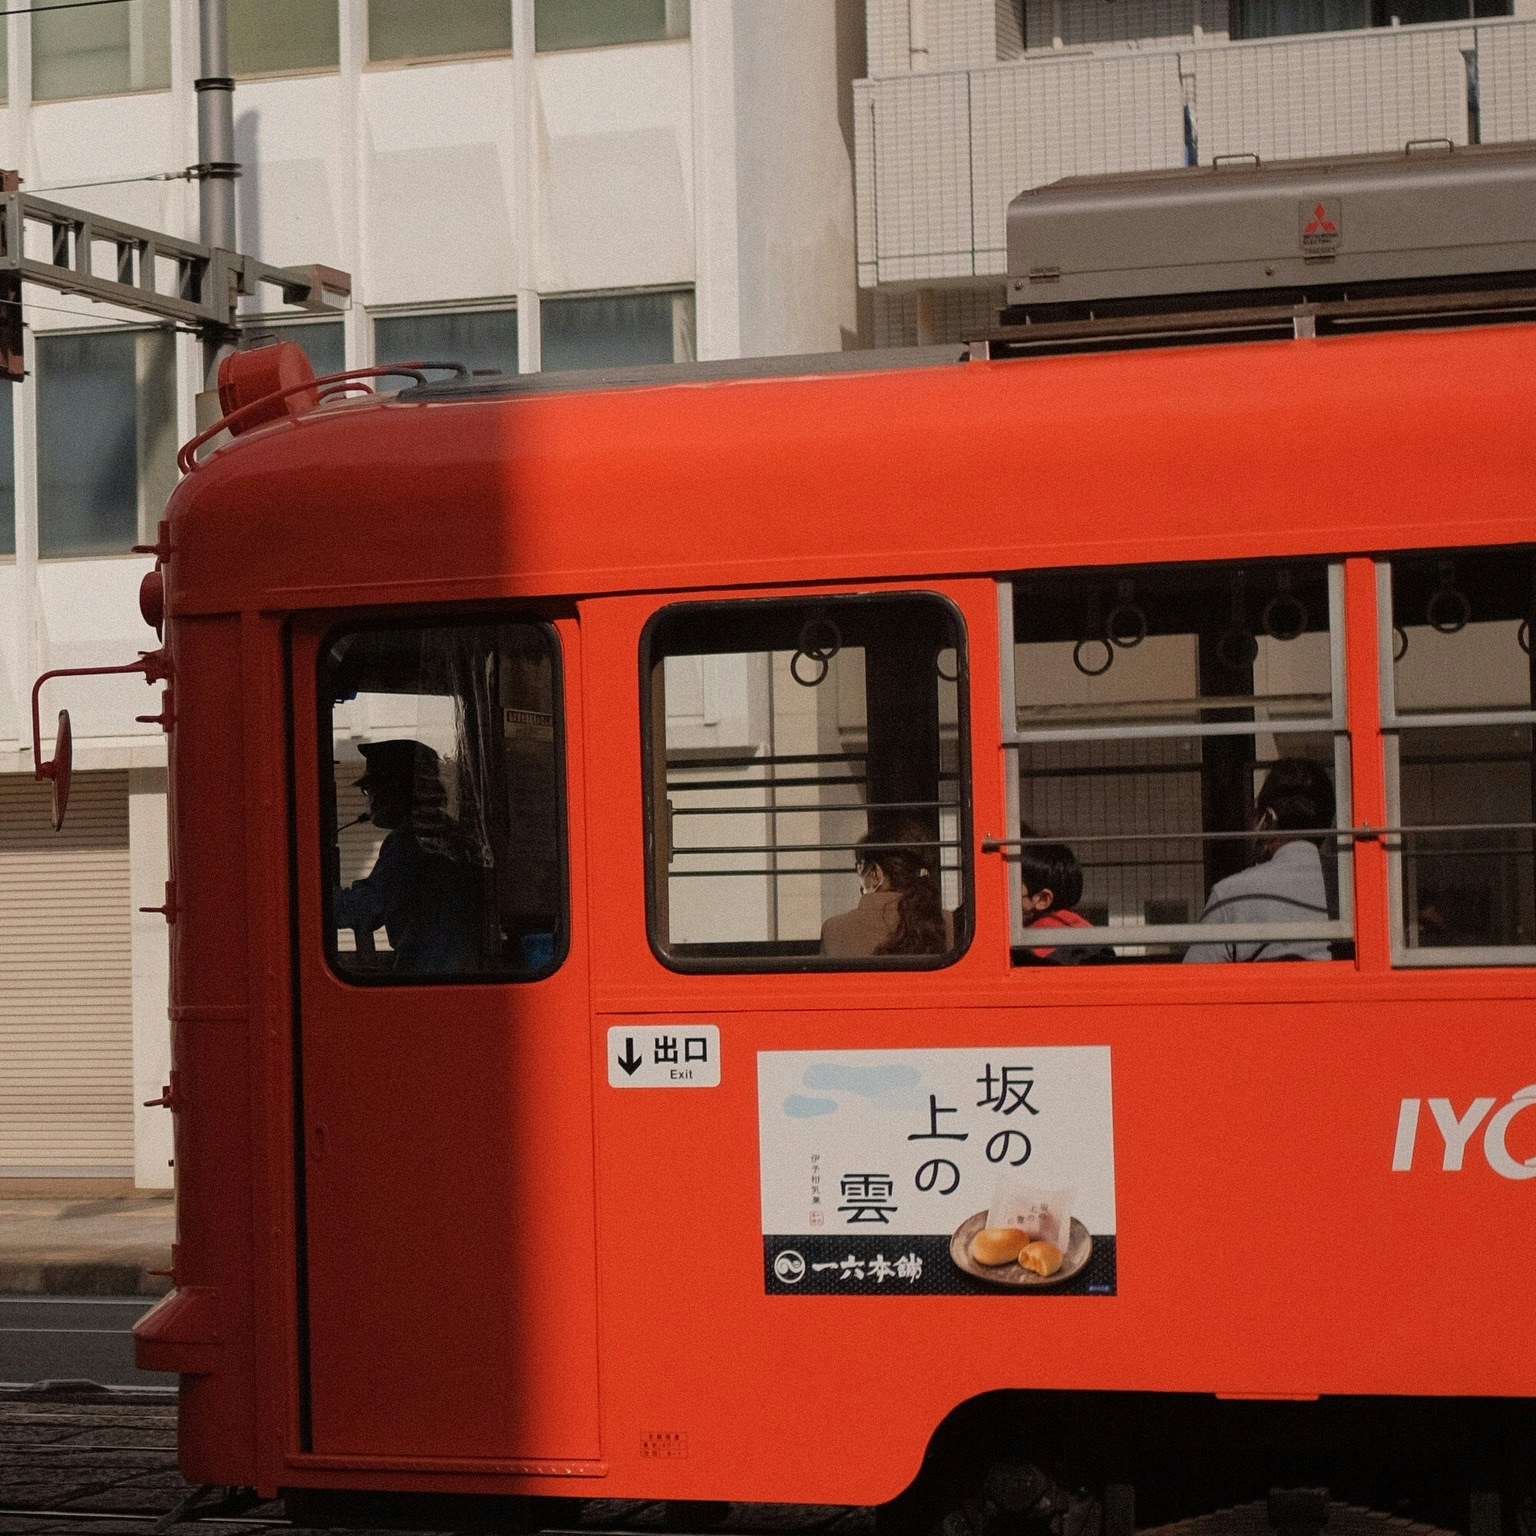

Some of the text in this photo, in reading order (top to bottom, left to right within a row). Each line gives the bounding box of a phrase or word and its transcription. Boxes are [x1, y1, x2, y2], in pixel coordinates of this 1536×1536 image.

[654, 1035, 707, 1064] 出口
[670, 1069, 693, 1080] Exit
[837, 1173, 899, 1224] 雲
